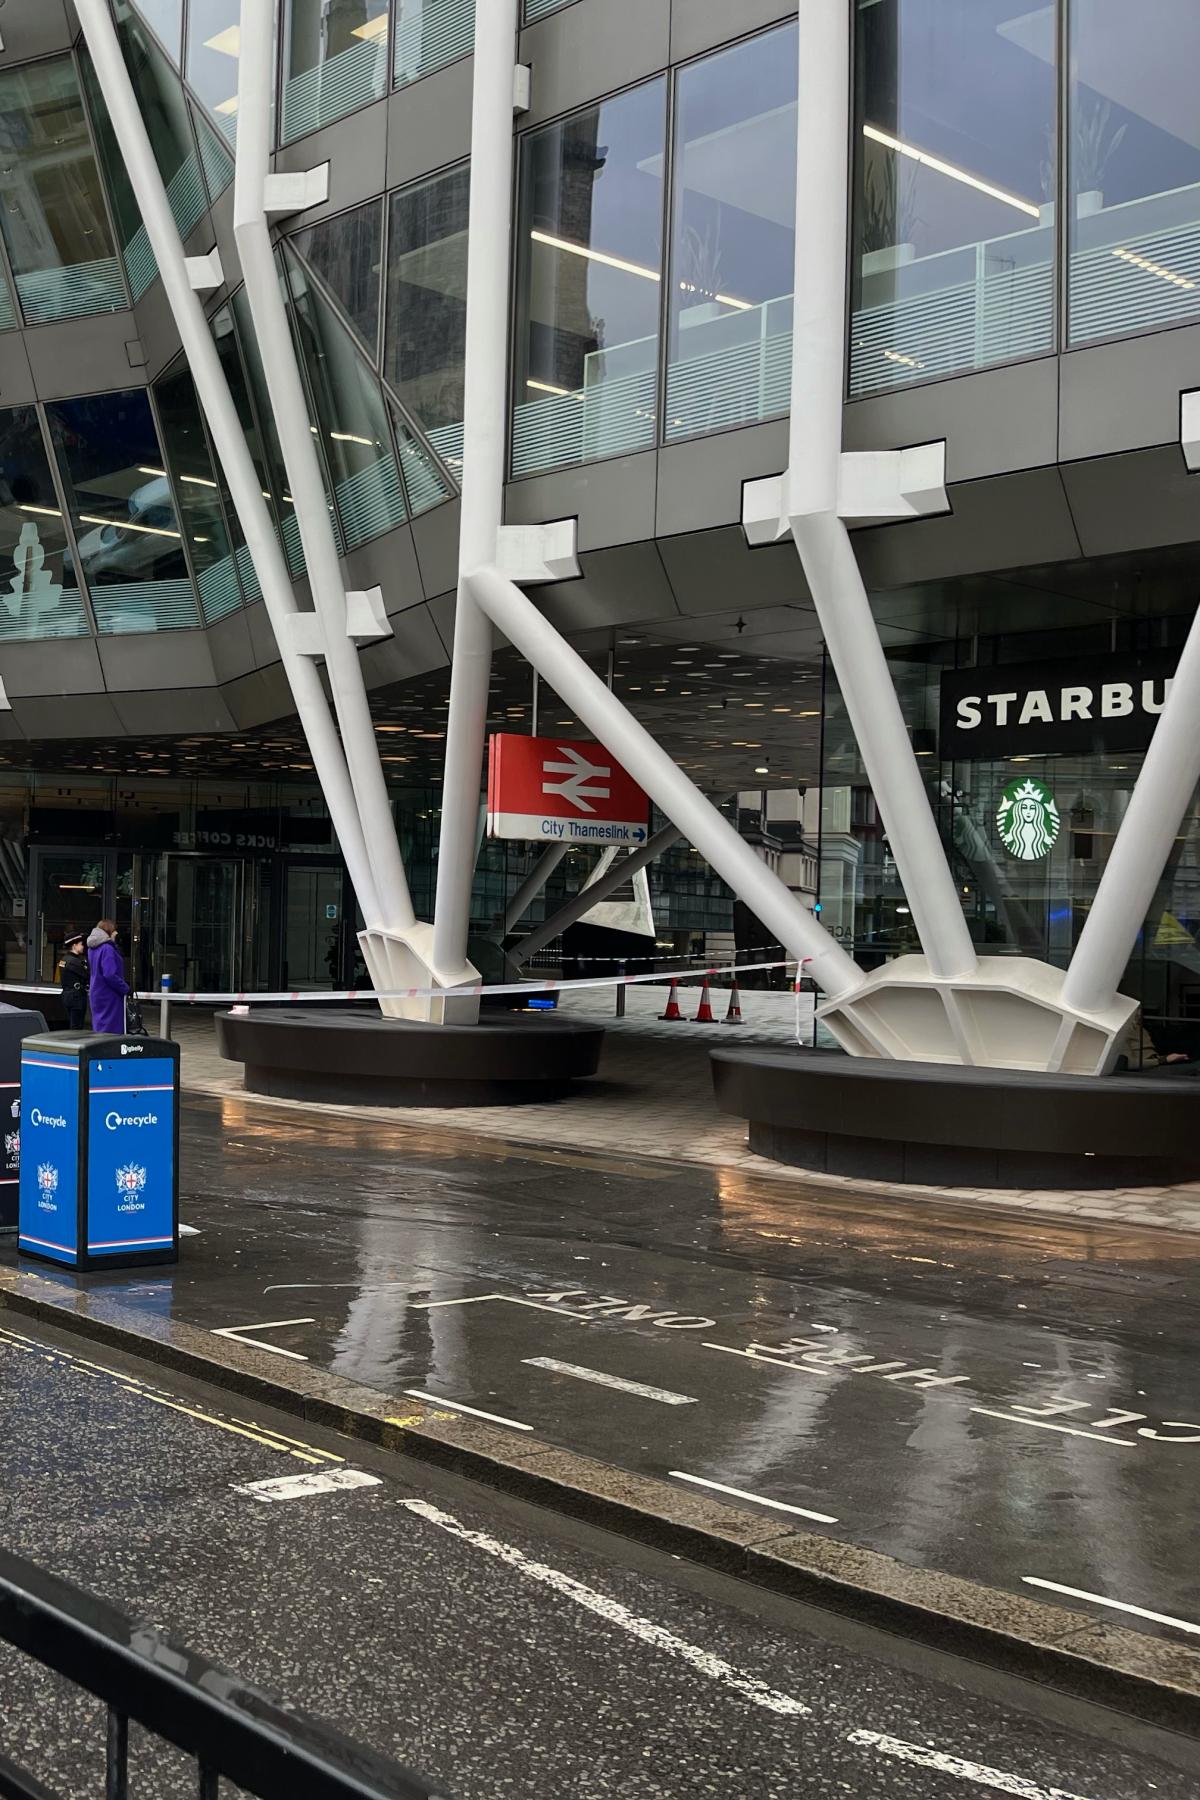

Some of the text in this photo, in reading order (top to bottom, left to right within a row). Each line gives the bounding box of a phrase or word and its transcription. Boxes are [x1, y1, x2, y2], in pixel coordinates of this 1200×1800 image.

[956, 678, 1175, 729] STARBU
[541, 820, 629, 839] City Thameslink
[42, 1113, 67, 1128] recycle
[122, 1112, 158, 1127] recycle
[42, 1193, 53, 1201] CITY
[123, 1194, 139, 1202] CITY
[37, 1201, 57, 1211] LONDON
[117, 1203, 145, 1211] LONDON
[527, 1291, 716, 1329] ONLY
[749, 1337, 970, 1388] HIRE
